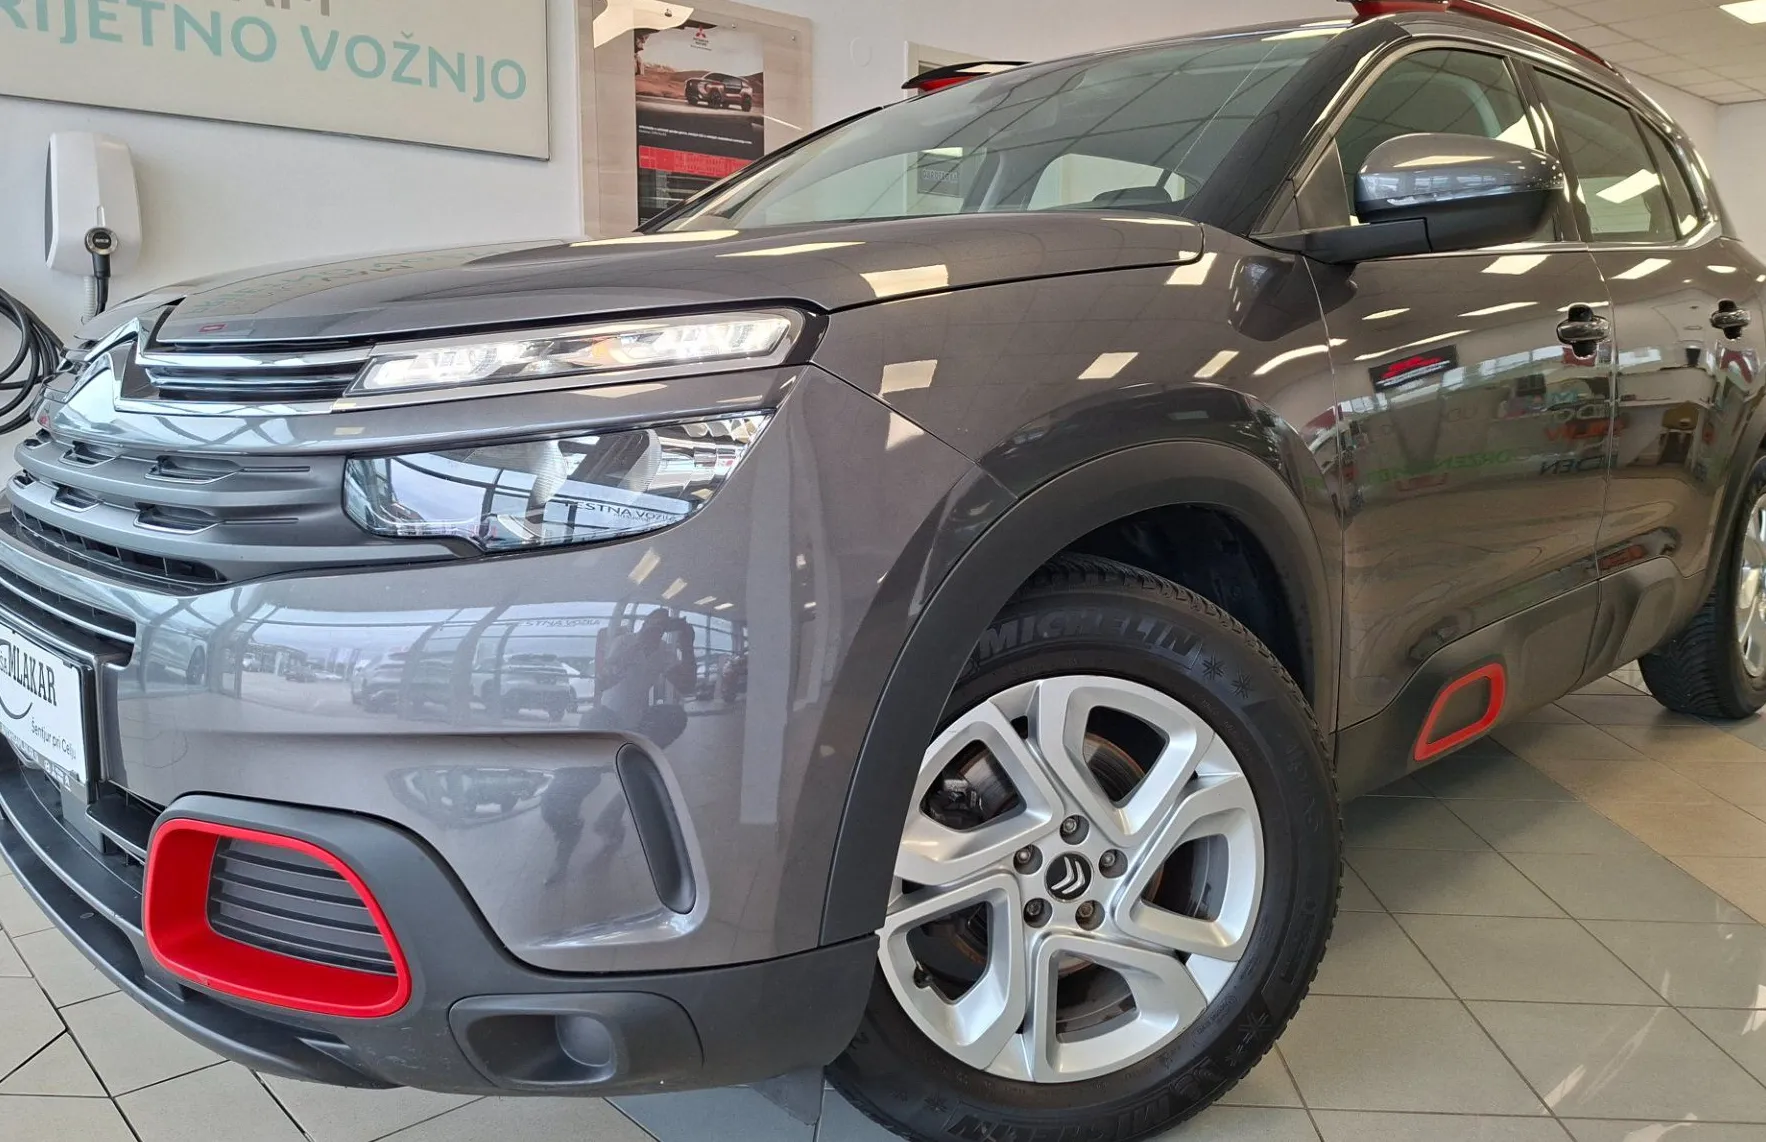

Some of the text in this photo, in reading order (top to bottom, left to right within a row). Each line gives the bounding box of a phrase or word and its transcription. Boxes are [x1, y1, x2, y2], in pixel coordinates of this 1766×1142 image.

[299, 25, 527, 103] VOŽNJO
[978, 609, 1199, 659] MICHELIN
[8, 644, 57, 706] MLAKAR
